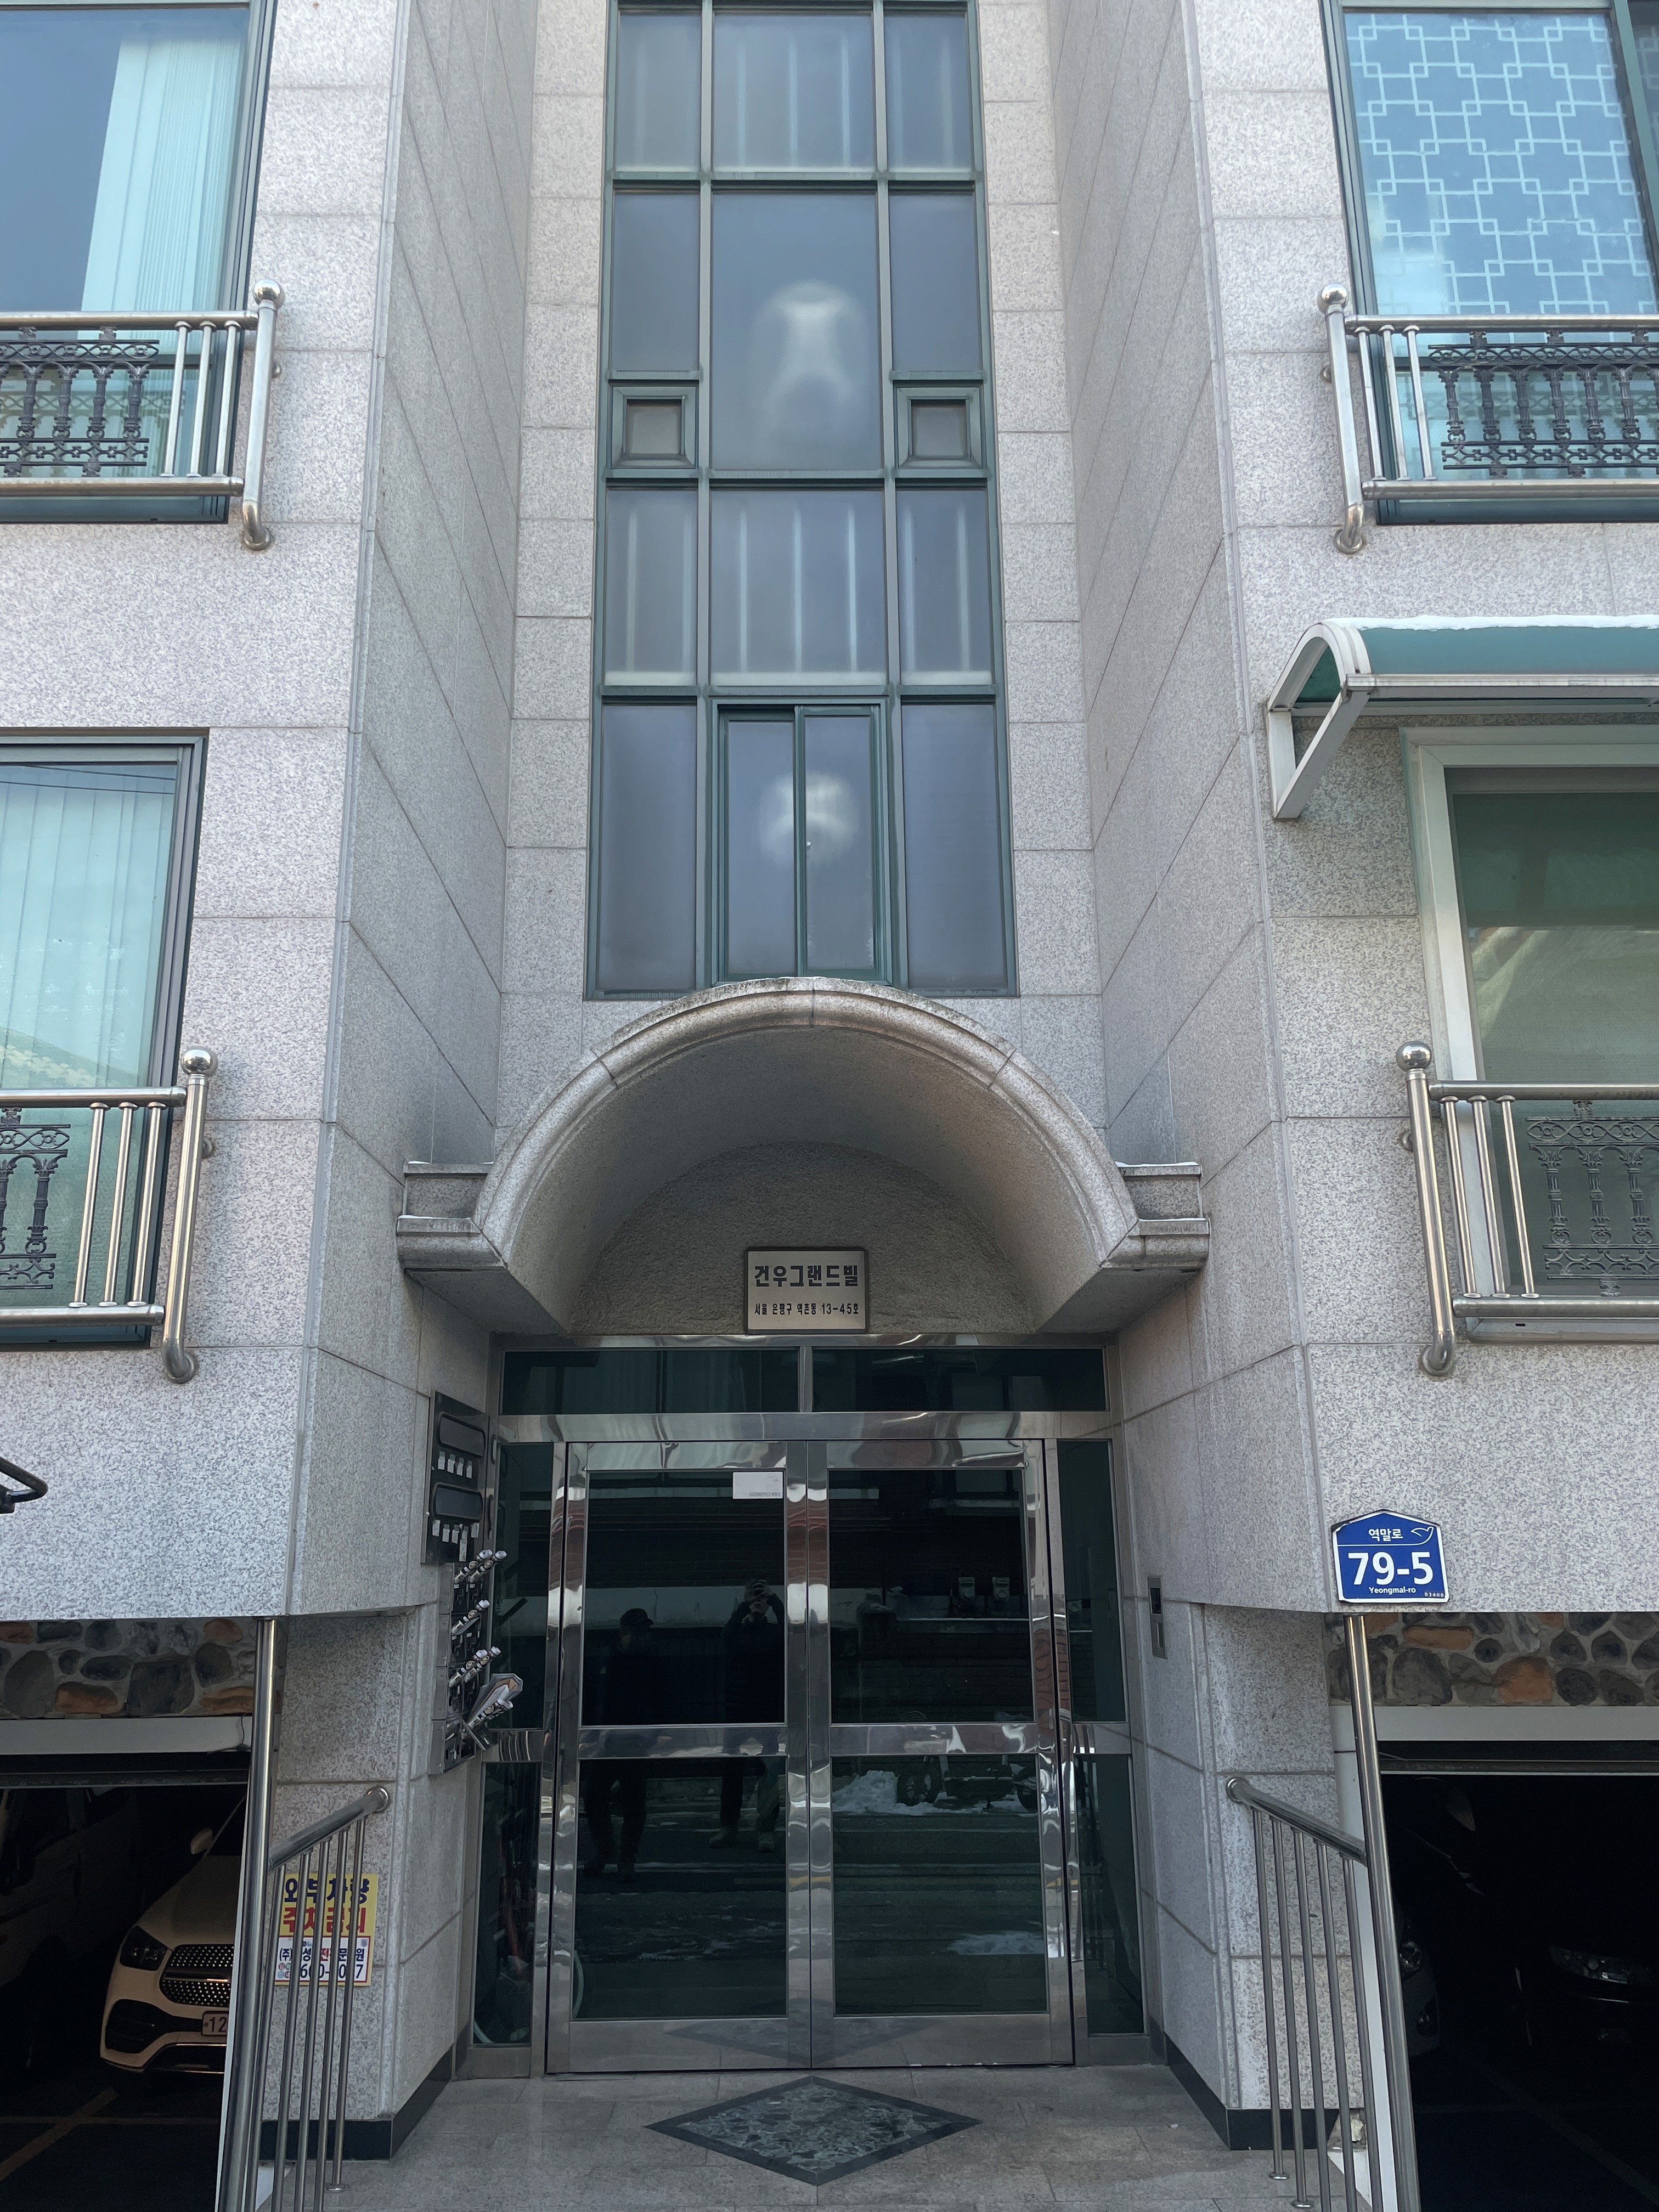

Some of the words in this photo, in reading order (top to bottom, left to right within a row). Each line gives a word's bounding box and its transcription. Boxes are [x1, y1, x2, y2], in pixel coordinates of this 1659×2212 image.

[754, 1265, 858, 1287] 건우그랜드빌
[754, 1303, 768, 1315] 서울
[772, 1303, 792, 1315] 은평구
[797, 1303, 816, 1315] 역촌동
[821, 1303, 859, 1314] 13-45호
[1368, 1528, 1403, 1542] 역말로
[1348, 1551, 1434, 1585] 79-5
[1369, 1586, 1417, 1595] Yeongmal-ro
